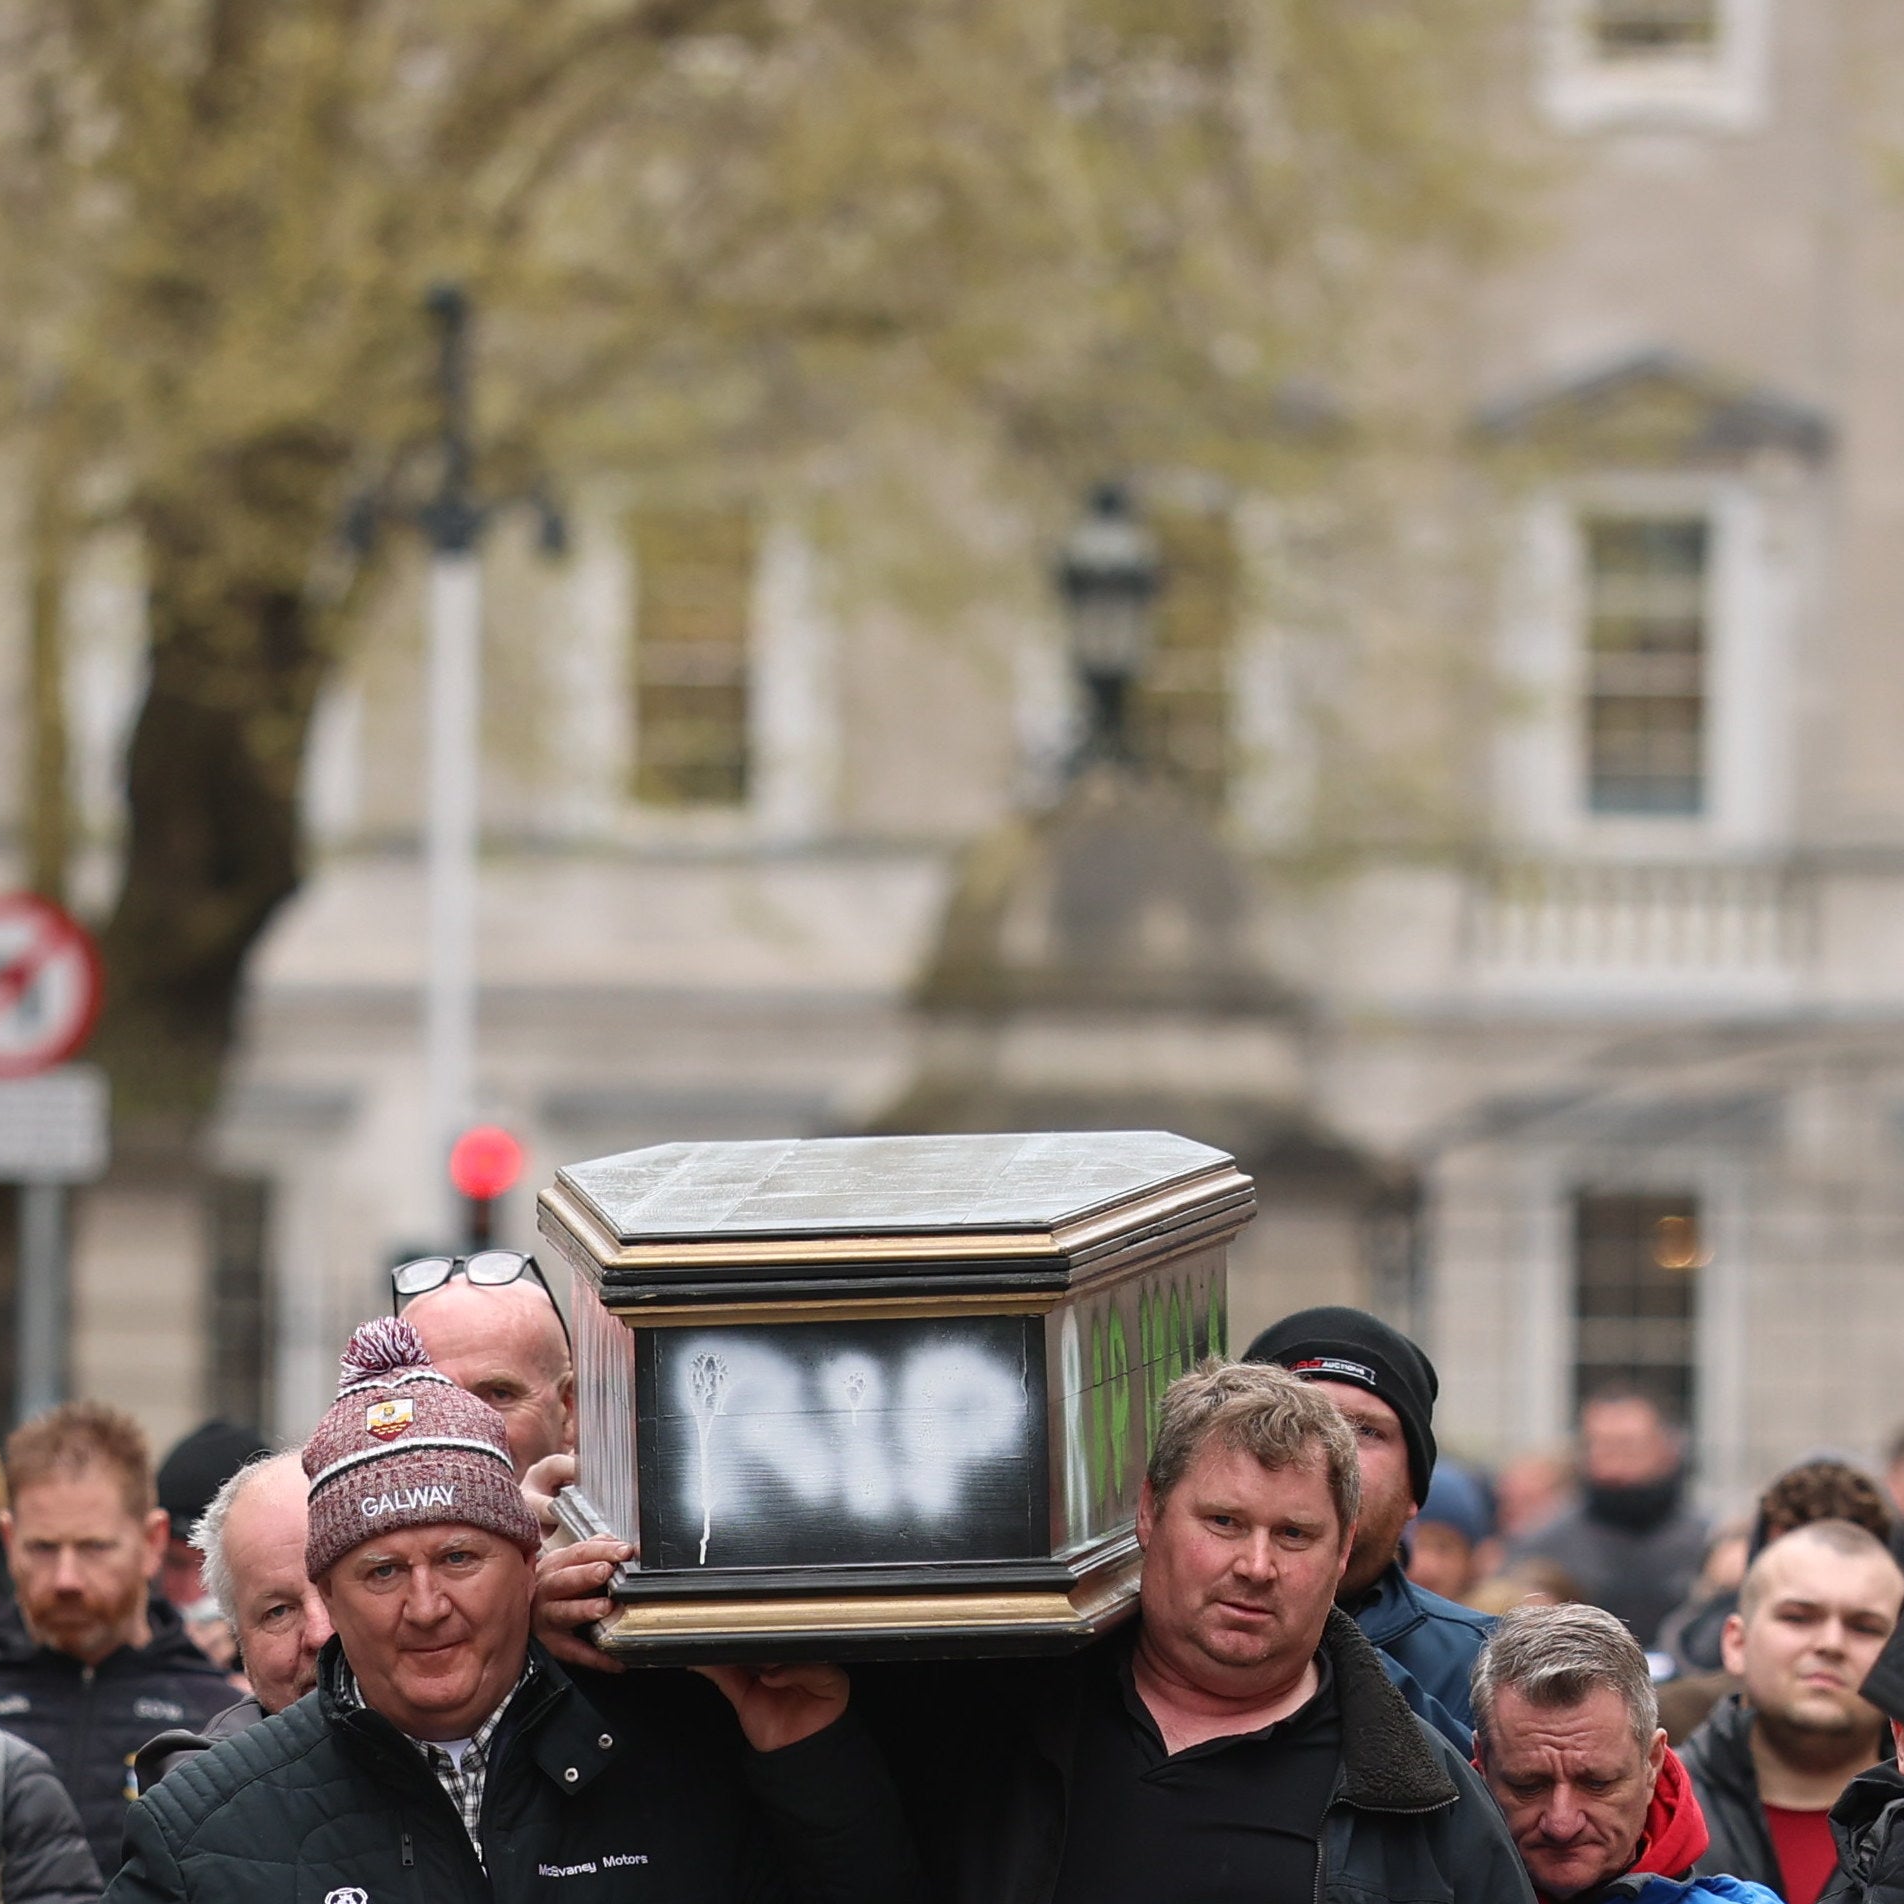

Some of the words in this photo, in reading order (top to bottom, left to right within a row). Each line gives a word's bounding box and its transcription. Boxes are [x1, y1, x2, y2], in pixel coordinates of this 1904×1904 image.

[1321, 1361, 1366, 1375] AUCTIONS
[361, 1485, 456, 1517] GALWAY
[602, 1853, 649, 1868] Motors
